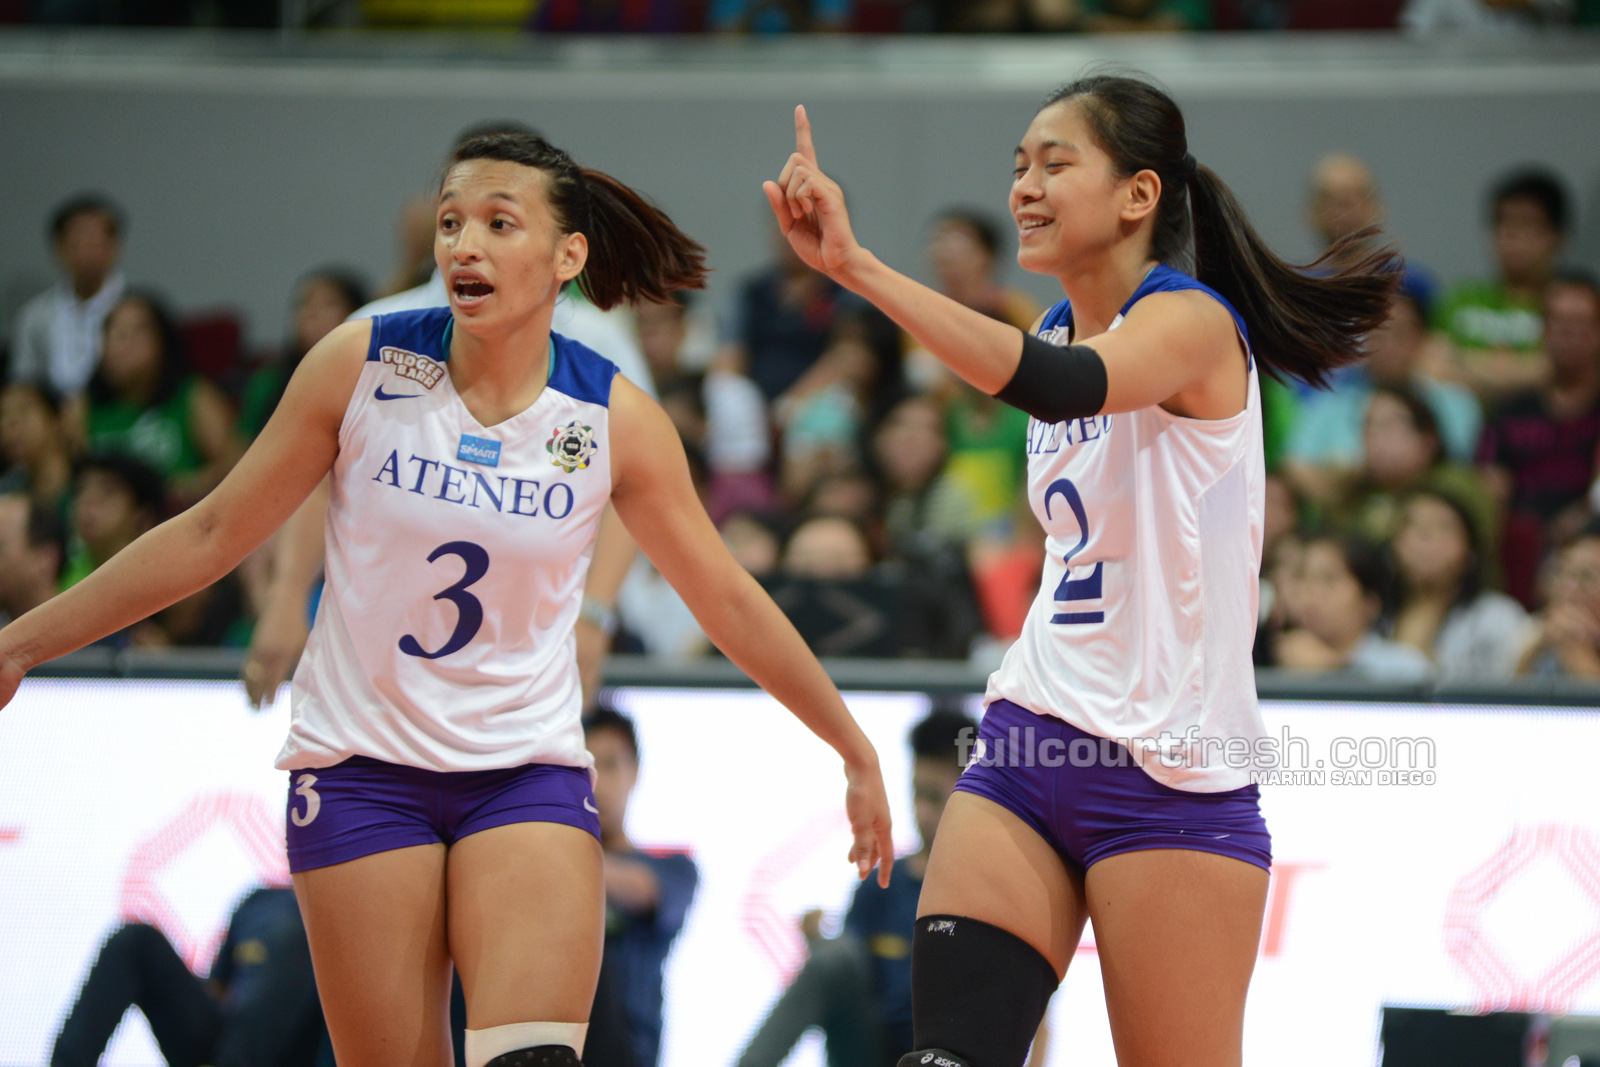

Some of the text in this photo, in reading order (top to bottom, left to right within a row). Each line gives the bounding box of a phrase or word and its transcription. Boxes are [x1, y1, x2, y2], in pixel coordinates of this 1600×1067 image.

[383, 349, 444, 380] FUDGEE
[396, 364, 436, 389] BARR
[459, 444, 499, 459] SMART
[372, 448, 574, 519] ATENEO
[1044, 477, 1104, 602] 2
[398, 540, 490, 659] 3
[291, 773, 321, 827] 3
